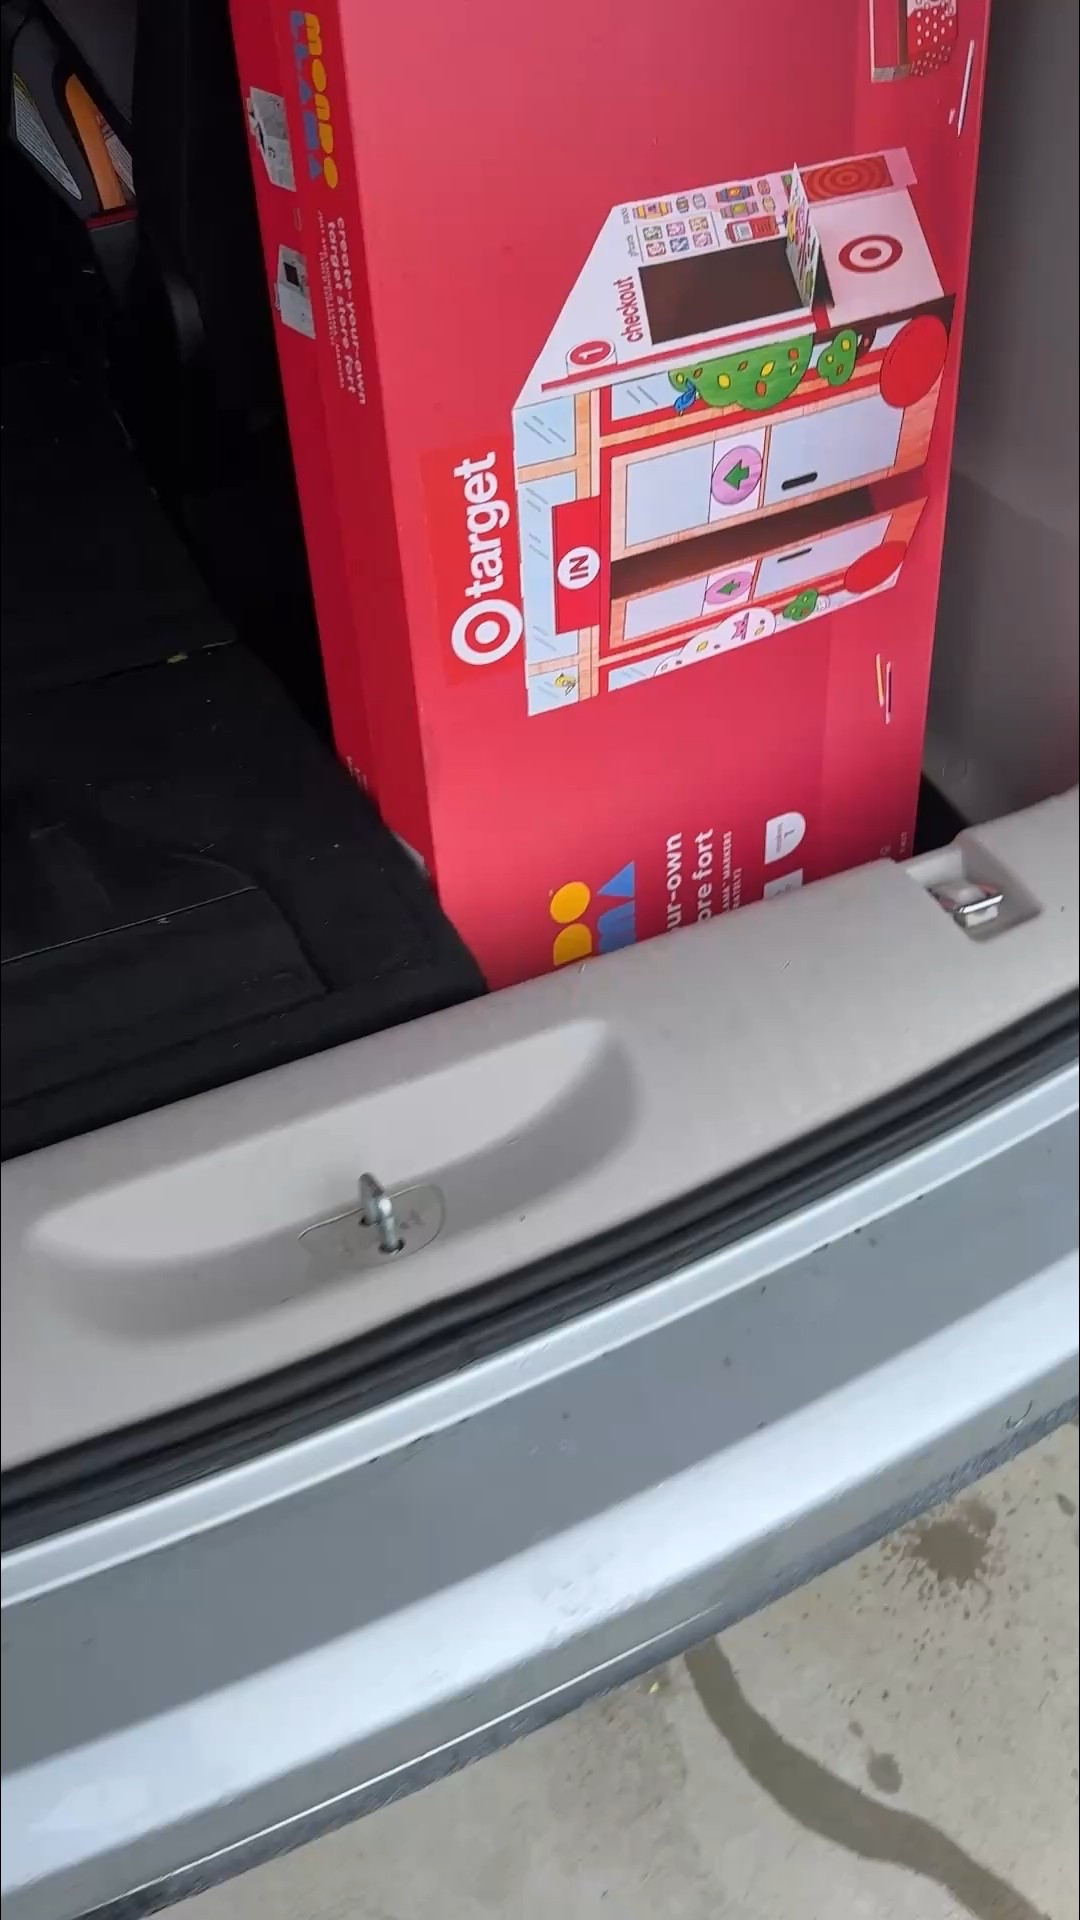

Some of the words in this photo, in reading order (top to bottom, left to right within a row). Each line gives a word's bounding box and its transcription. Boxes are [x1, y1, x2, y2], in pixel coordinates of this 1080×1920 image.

[327, 221, 343, 290] target
[337, 296, 349, 349] store
[344, 355, 356, 393] fort
[337, 216, 366, 404] create-your-own
[613, 276, 644, 343] checkout
[578, 347, 604, 361] 1
[454, 451, 510, 599] target
[569, 554, 590, 581] IN
[666, 832, 683, 929] ur-own
[691, 827, 714, 881] fort
[698, 882, 713, 923] ore
